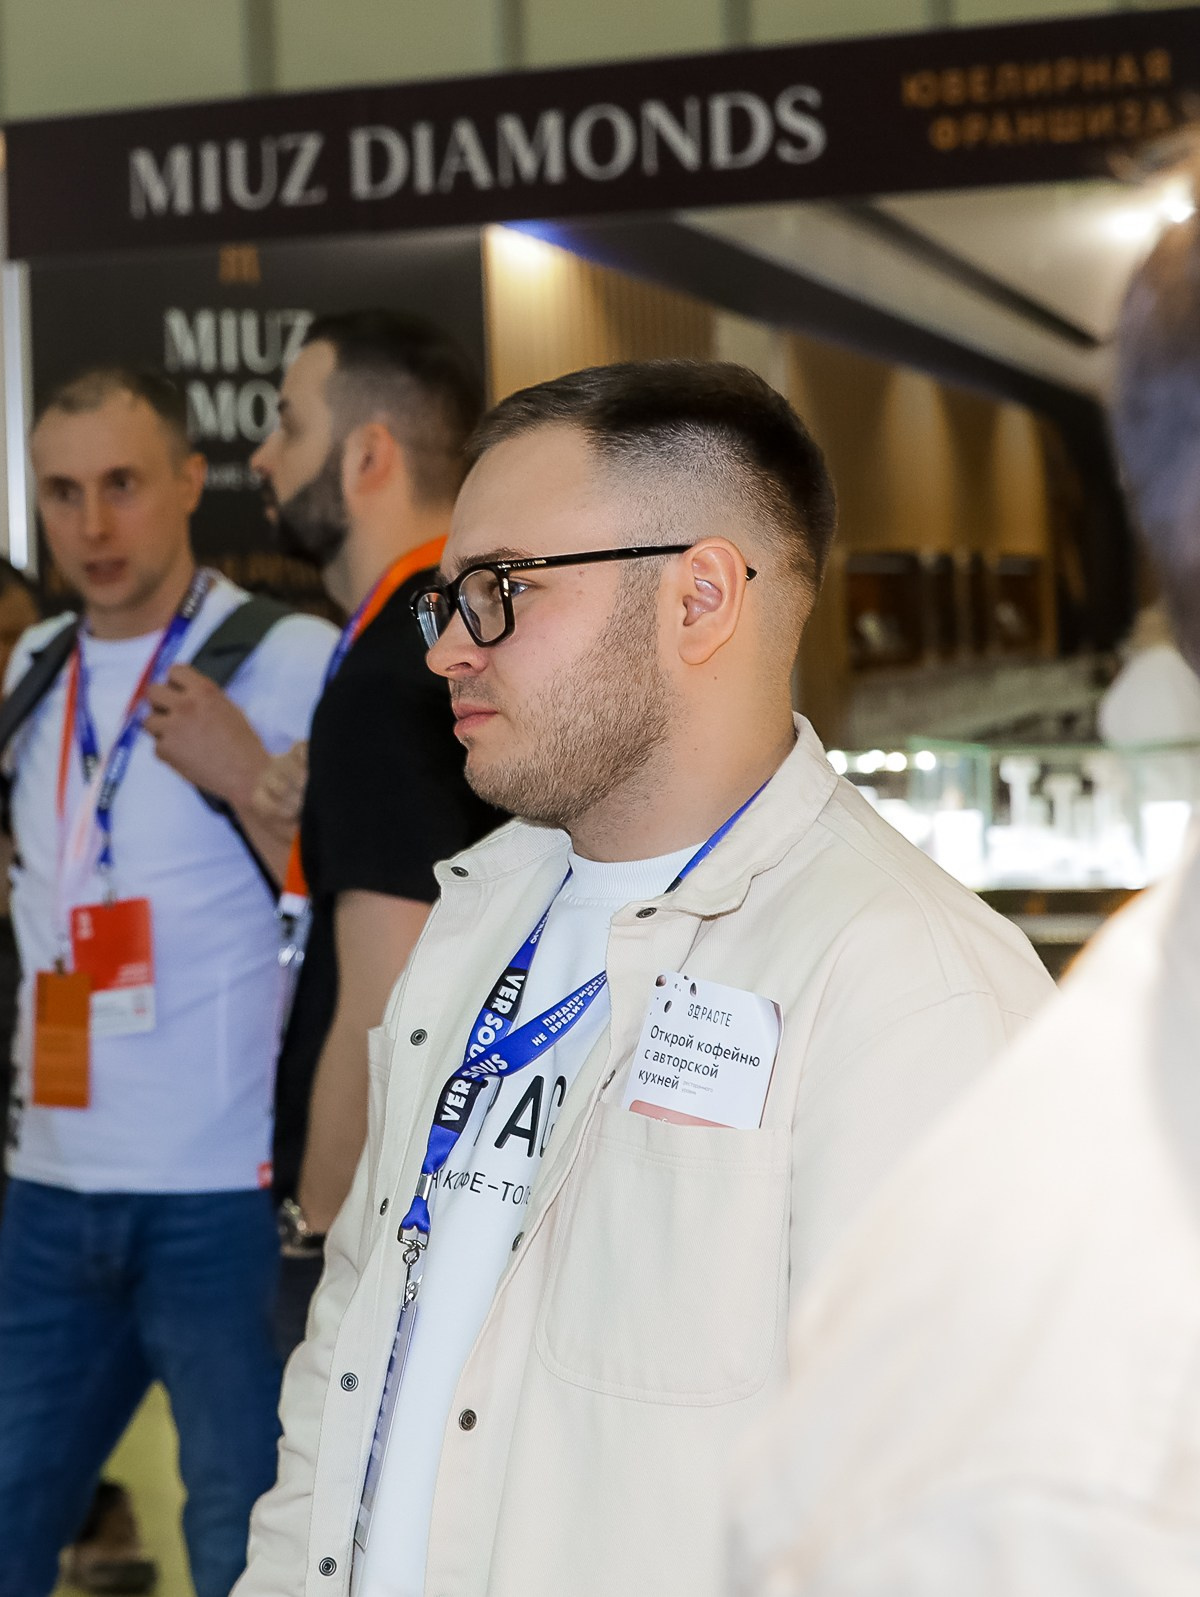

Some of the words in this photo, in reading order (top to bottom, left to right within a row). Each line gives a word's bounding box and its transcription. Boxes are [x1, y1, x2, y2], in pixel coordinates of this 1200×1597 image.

[128, 130, 328, 219] MIUZ
[349, 84, 827, 201] DIAMONDS
[163, 306, 315, 374] MIUZ
[186, 379, 281, 443] MO
[531, 1032, 548, 1047] НЕ
[548, 1000, 586, 1034] ВРЕДИТ
[650, 1025, 694, 1049] Открой
[696, 1041, 761, 1067] кофейню
[638, 1069, 680, 1090] кухней
[644, 1049, 651, 1060] с
[652, 1050, 720, 1079] авторской
